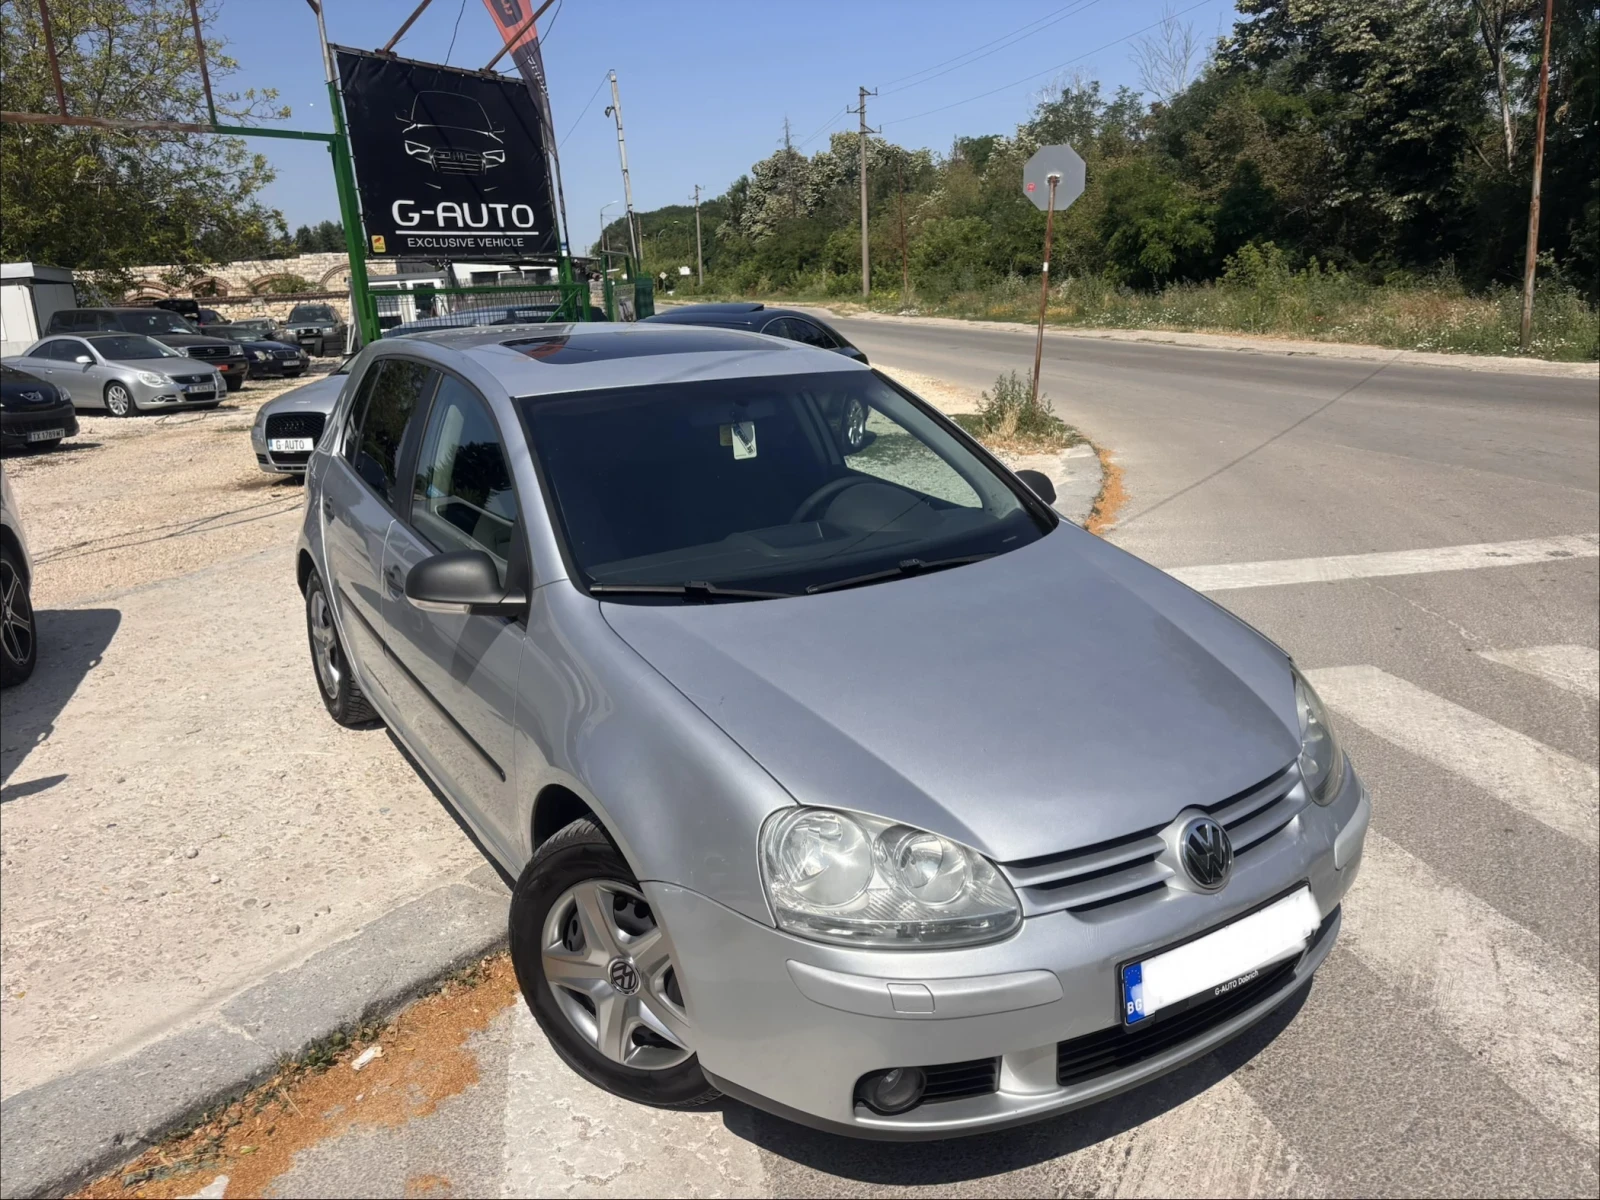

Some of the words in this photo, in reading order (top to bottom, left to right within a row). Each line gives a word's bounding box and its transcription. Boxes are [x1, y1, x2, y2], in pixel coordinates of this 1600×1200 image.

[391, 199, 535, 228] G-AUTO
[407, 237, 476, 248] EXCLUSIVE
[477, 237, 525, 248] VEHICLE
[1214, 980, 1238, 996] G-AUTO
[1238, 969, 1259, 985] Dobrich
[1127, 998, 1143, 1015] BG
